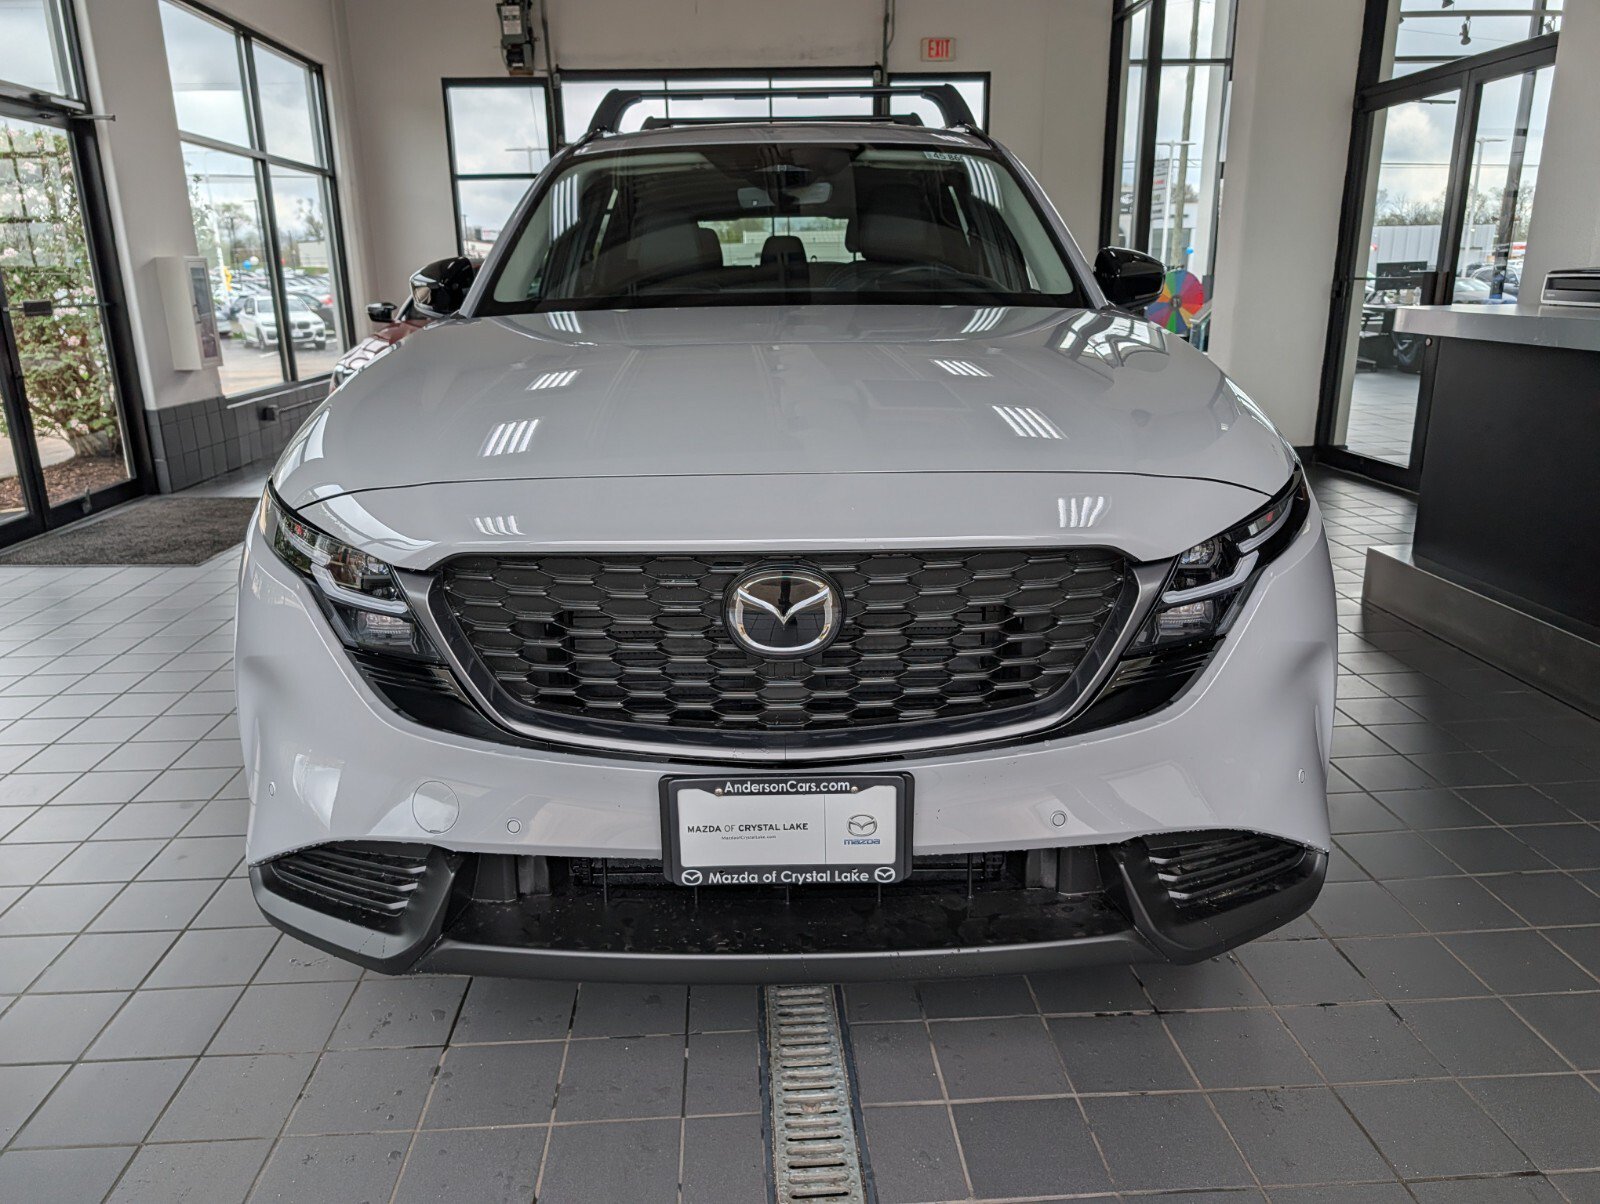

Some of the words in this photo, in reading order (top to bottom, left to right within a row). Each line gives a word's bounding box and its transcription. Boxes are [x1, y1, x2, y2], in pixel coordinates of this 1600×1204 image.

[928, 39, 950, 58] EXIT
[724, 780, 850, 793] AndersonCars.com
[687, 825, 722, 833] MAZDA
[724, 824, 735, 832] OF
[738, 823, 780, 832] CRYSTAL
[783, 822, 809, 831] LAKE
[708, 871, 758, 884] Mazda
[762, 870, 776, 883] of
[780, 870, 830, 885] Crystal
[834, 870, 869, 882] Lake
